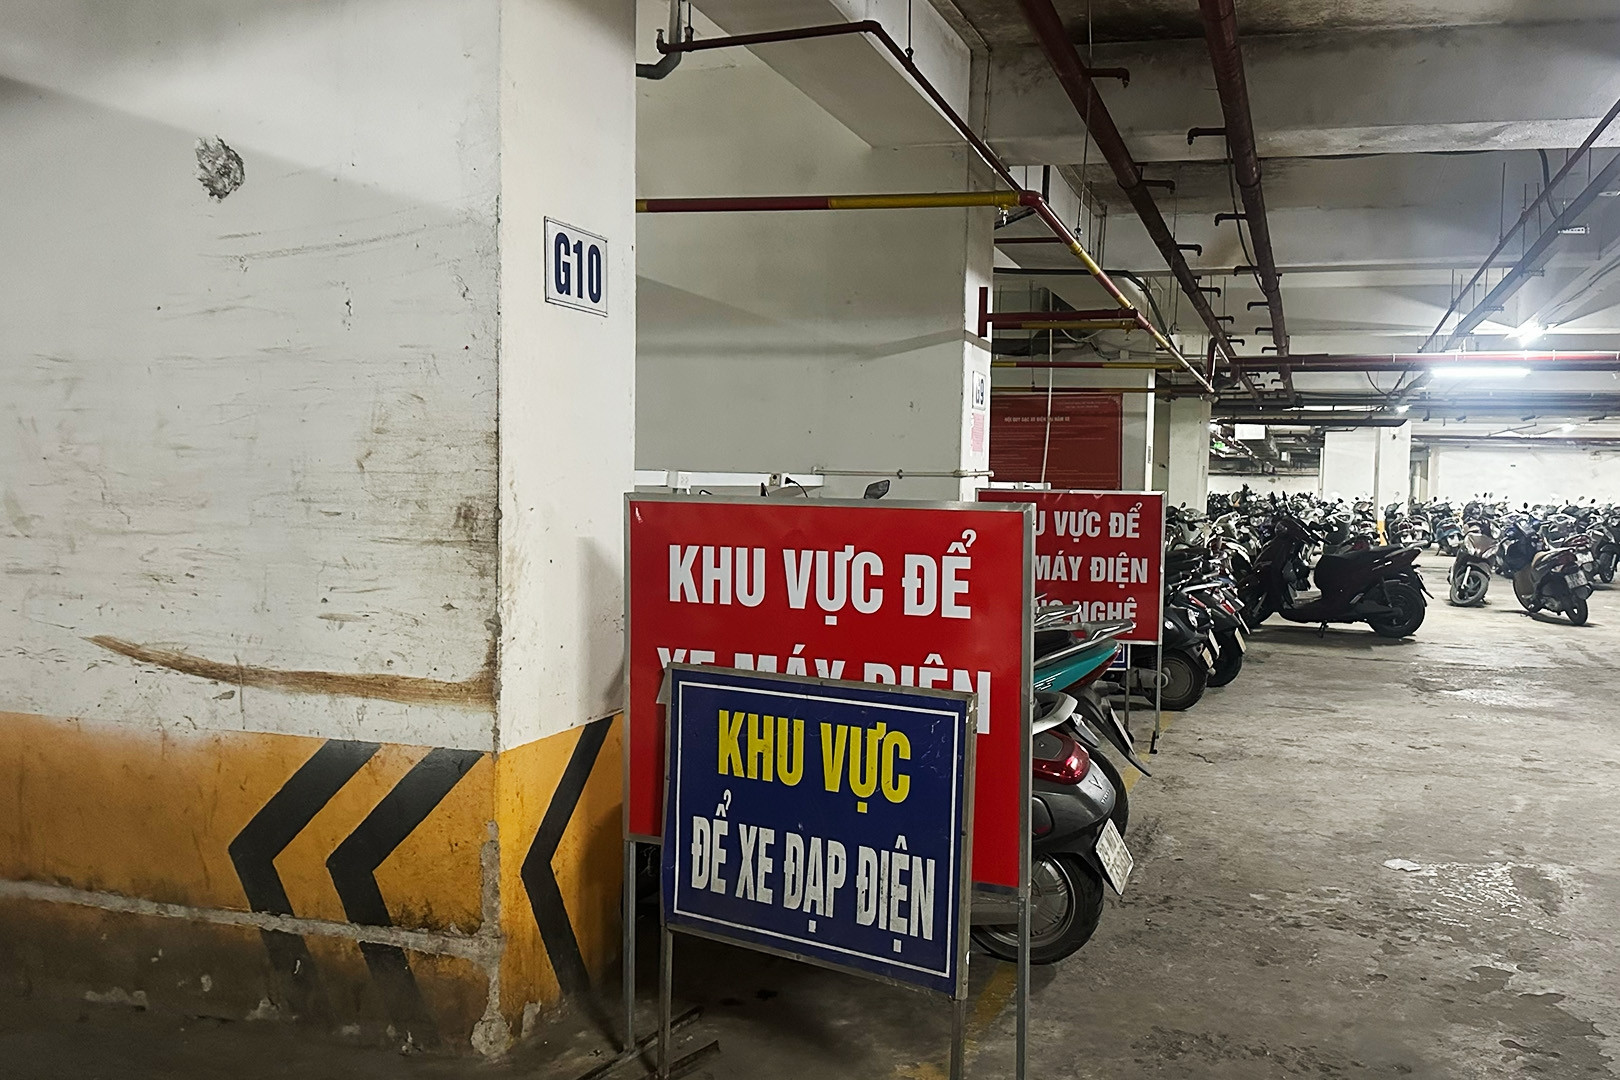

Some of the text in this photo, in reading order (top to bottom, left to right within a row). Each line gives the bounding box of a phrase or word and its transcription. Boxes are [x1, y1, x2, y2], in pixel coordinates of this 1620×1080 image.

[554, 232, 602, 304] G10
[1054, 508, 1101, 542] VỰC
[1109, 502, 1143, 538] ĐỂ
[669, 529, 977, 625] KHU VỰC ĐỂ
[1035, 550, 1148, 588] MÁY ĐIỆN
[718, 709, 911, 813] KHU VỰC
[691, 789, 936, 953] ĐỂ XE ĐẠP ĐIỆN
